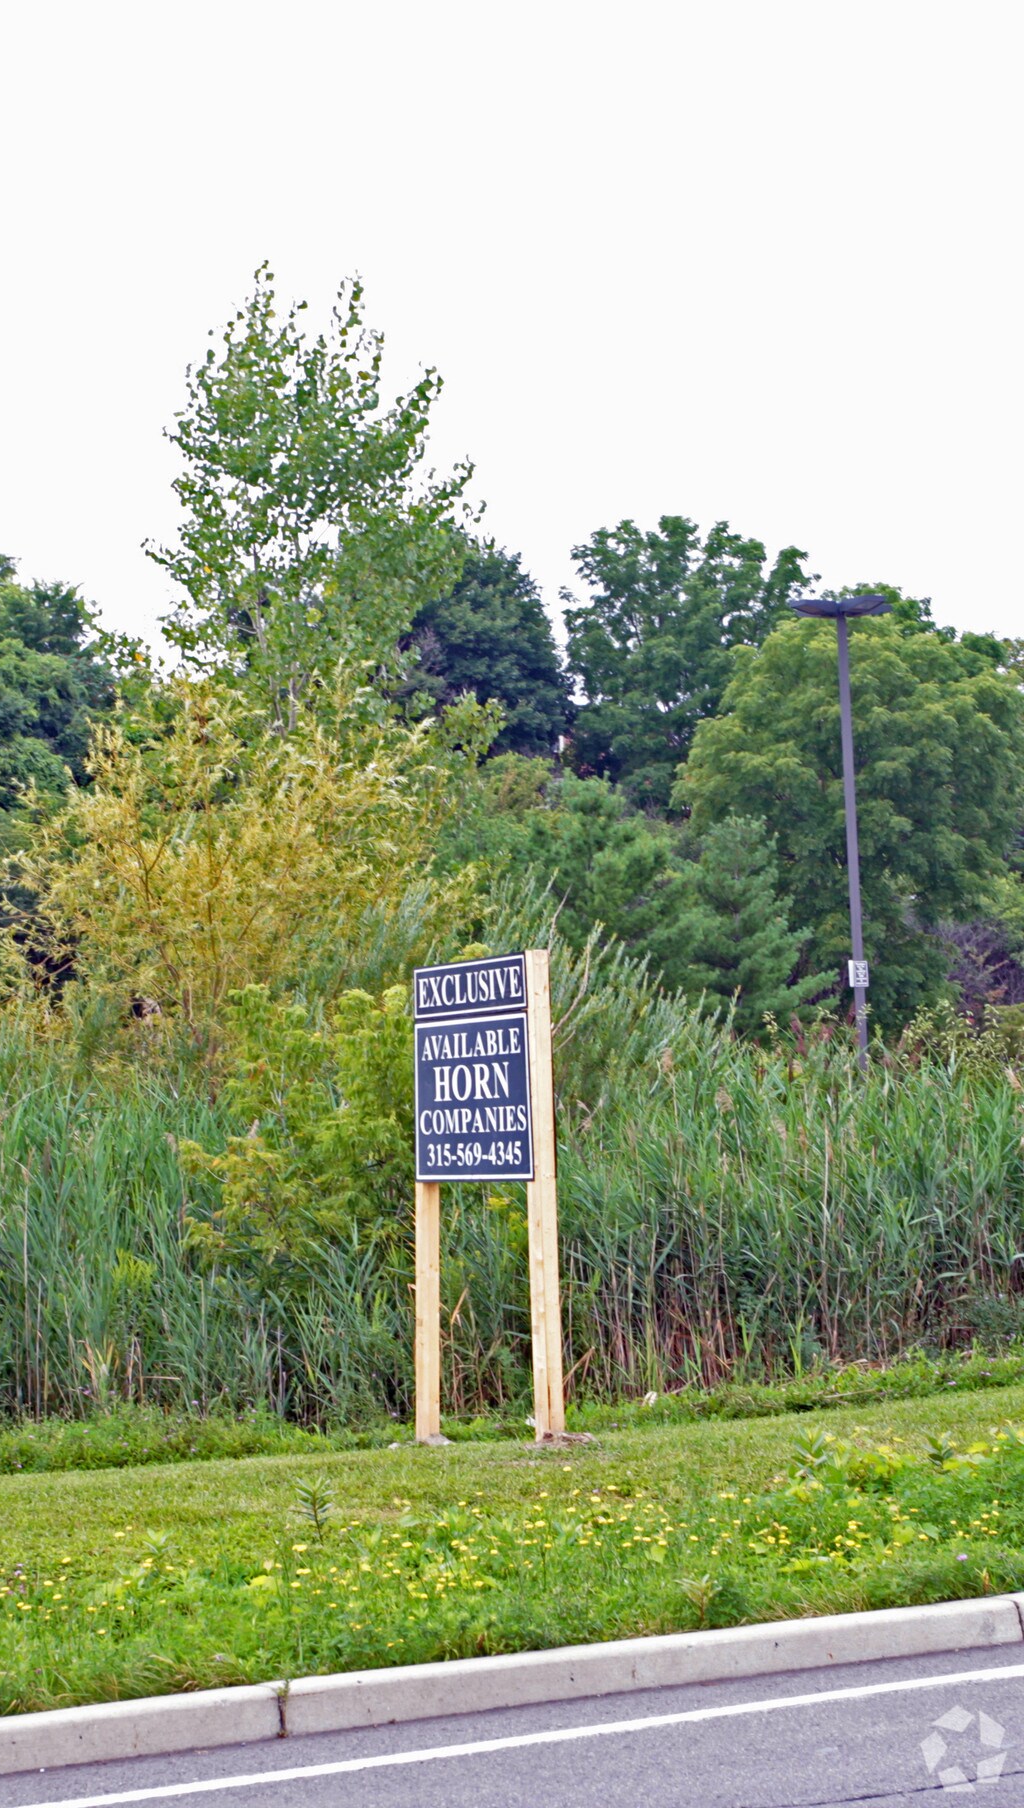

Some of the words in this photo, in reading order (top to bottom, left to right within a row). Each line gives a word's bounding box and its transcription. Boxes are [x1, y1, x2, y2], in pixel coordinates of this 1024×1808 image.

[418, 965, 522, 1008] EXCLUSIVE
[421, 1027, 521, 1061] AVAILABLE
[433, 1062, 509, 1102] HORN
[420, 1105, 527, 1135] COMPANIES
[427, 1141, 522, 1167] 315-569-4345
